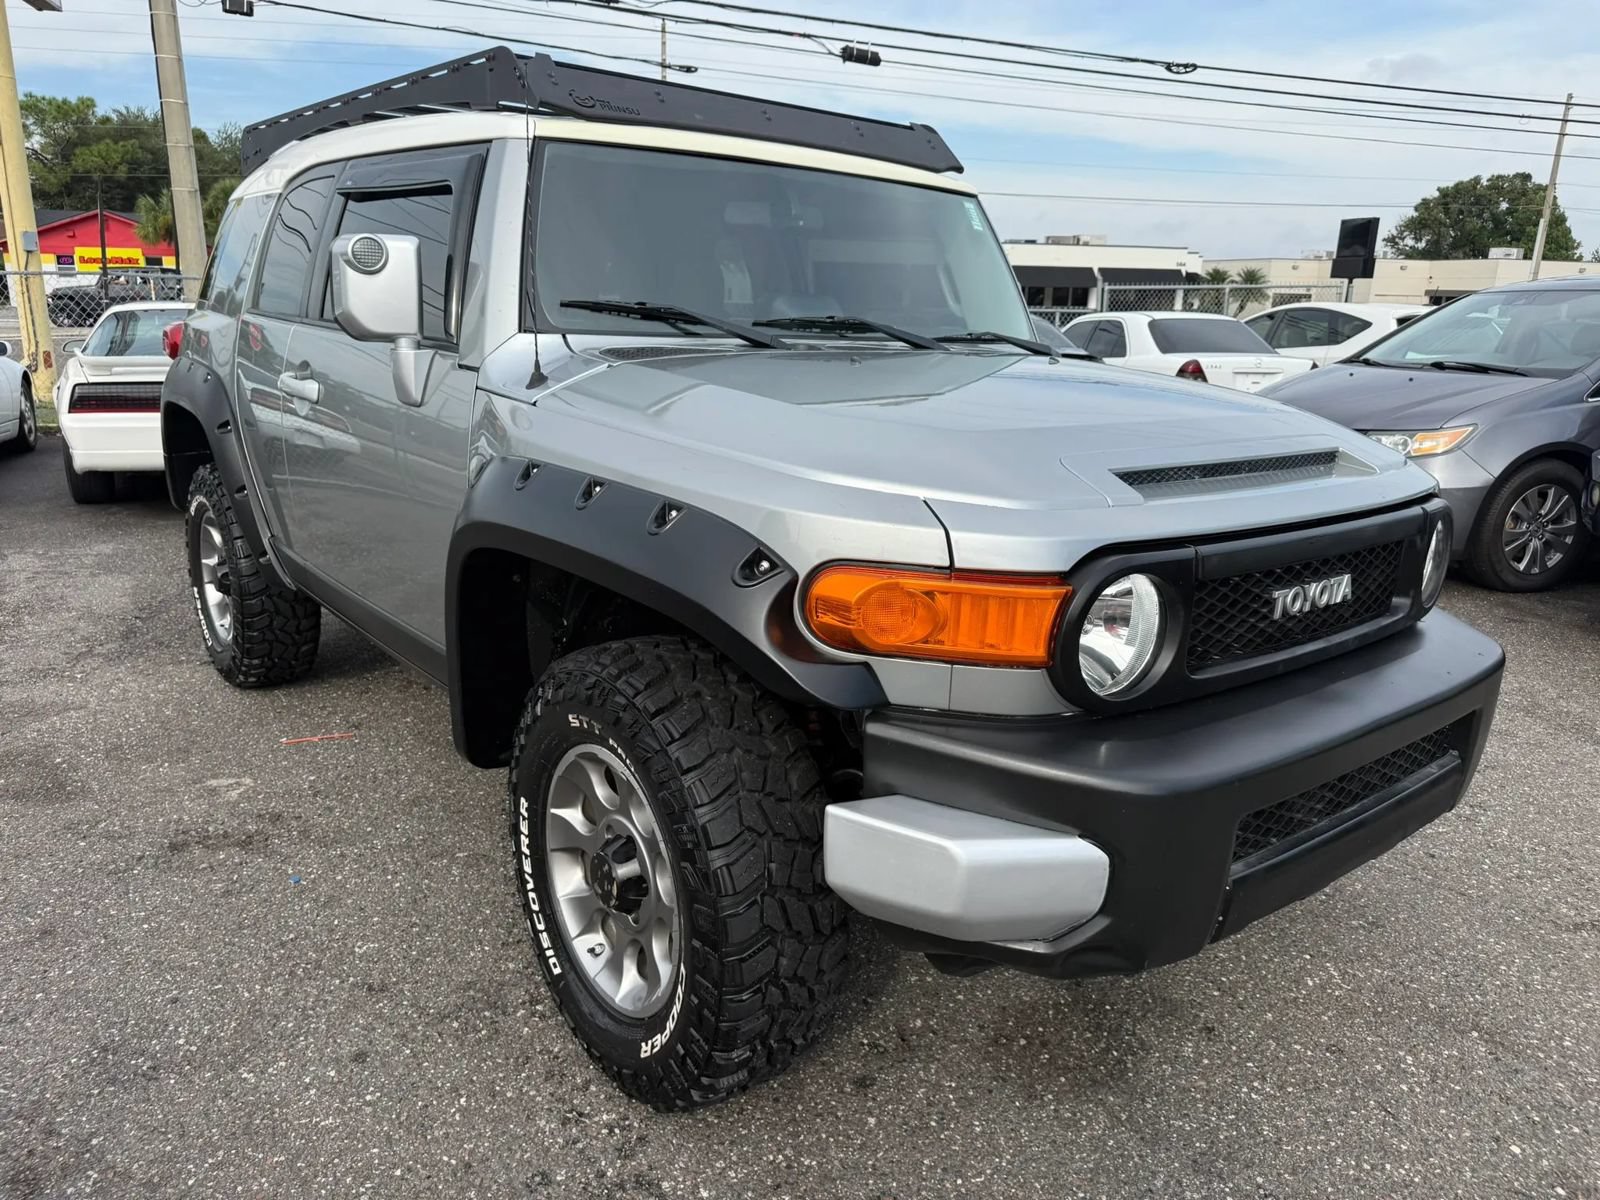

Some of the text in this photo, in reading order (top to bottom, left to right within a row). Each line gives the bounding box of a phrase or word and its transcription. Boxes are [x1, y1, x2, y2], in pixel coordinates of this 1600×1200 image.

[599, 102, 641, 116] PRINSU
[1272, 574, 1352, 620] TOYOTA
[568, 713, 602, 735] STT
[519, 796, 563, 976] DISCOVERER
[640, 962, 687, 1059] COOPER
